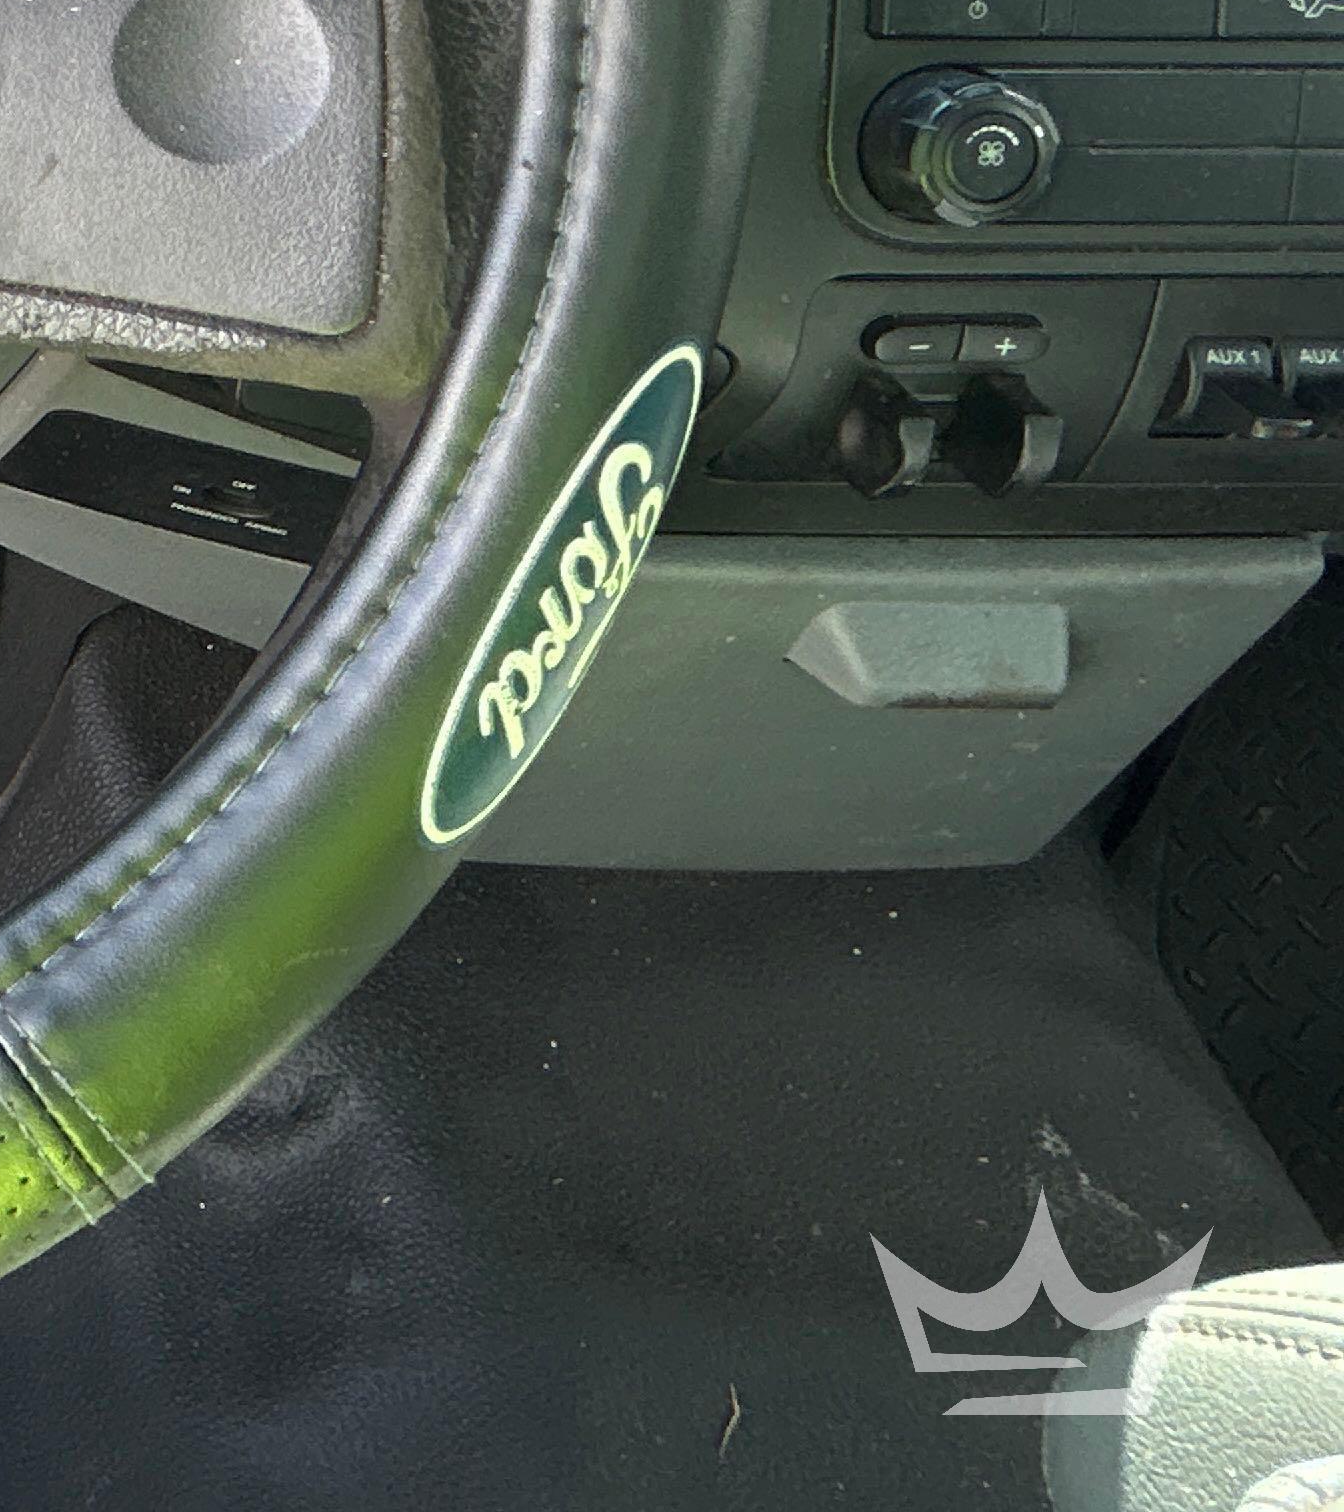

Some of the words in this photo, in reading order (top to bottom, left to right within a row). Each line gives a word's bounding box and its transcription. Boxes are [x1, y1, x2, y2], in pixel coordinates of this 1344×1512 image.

[1206, 348, 1247, 365] AUX
[1250, 348, 1261, 364] 1
[1299, 348, 1341, 365] AUX
[478, 442, 665, 760] Ford
